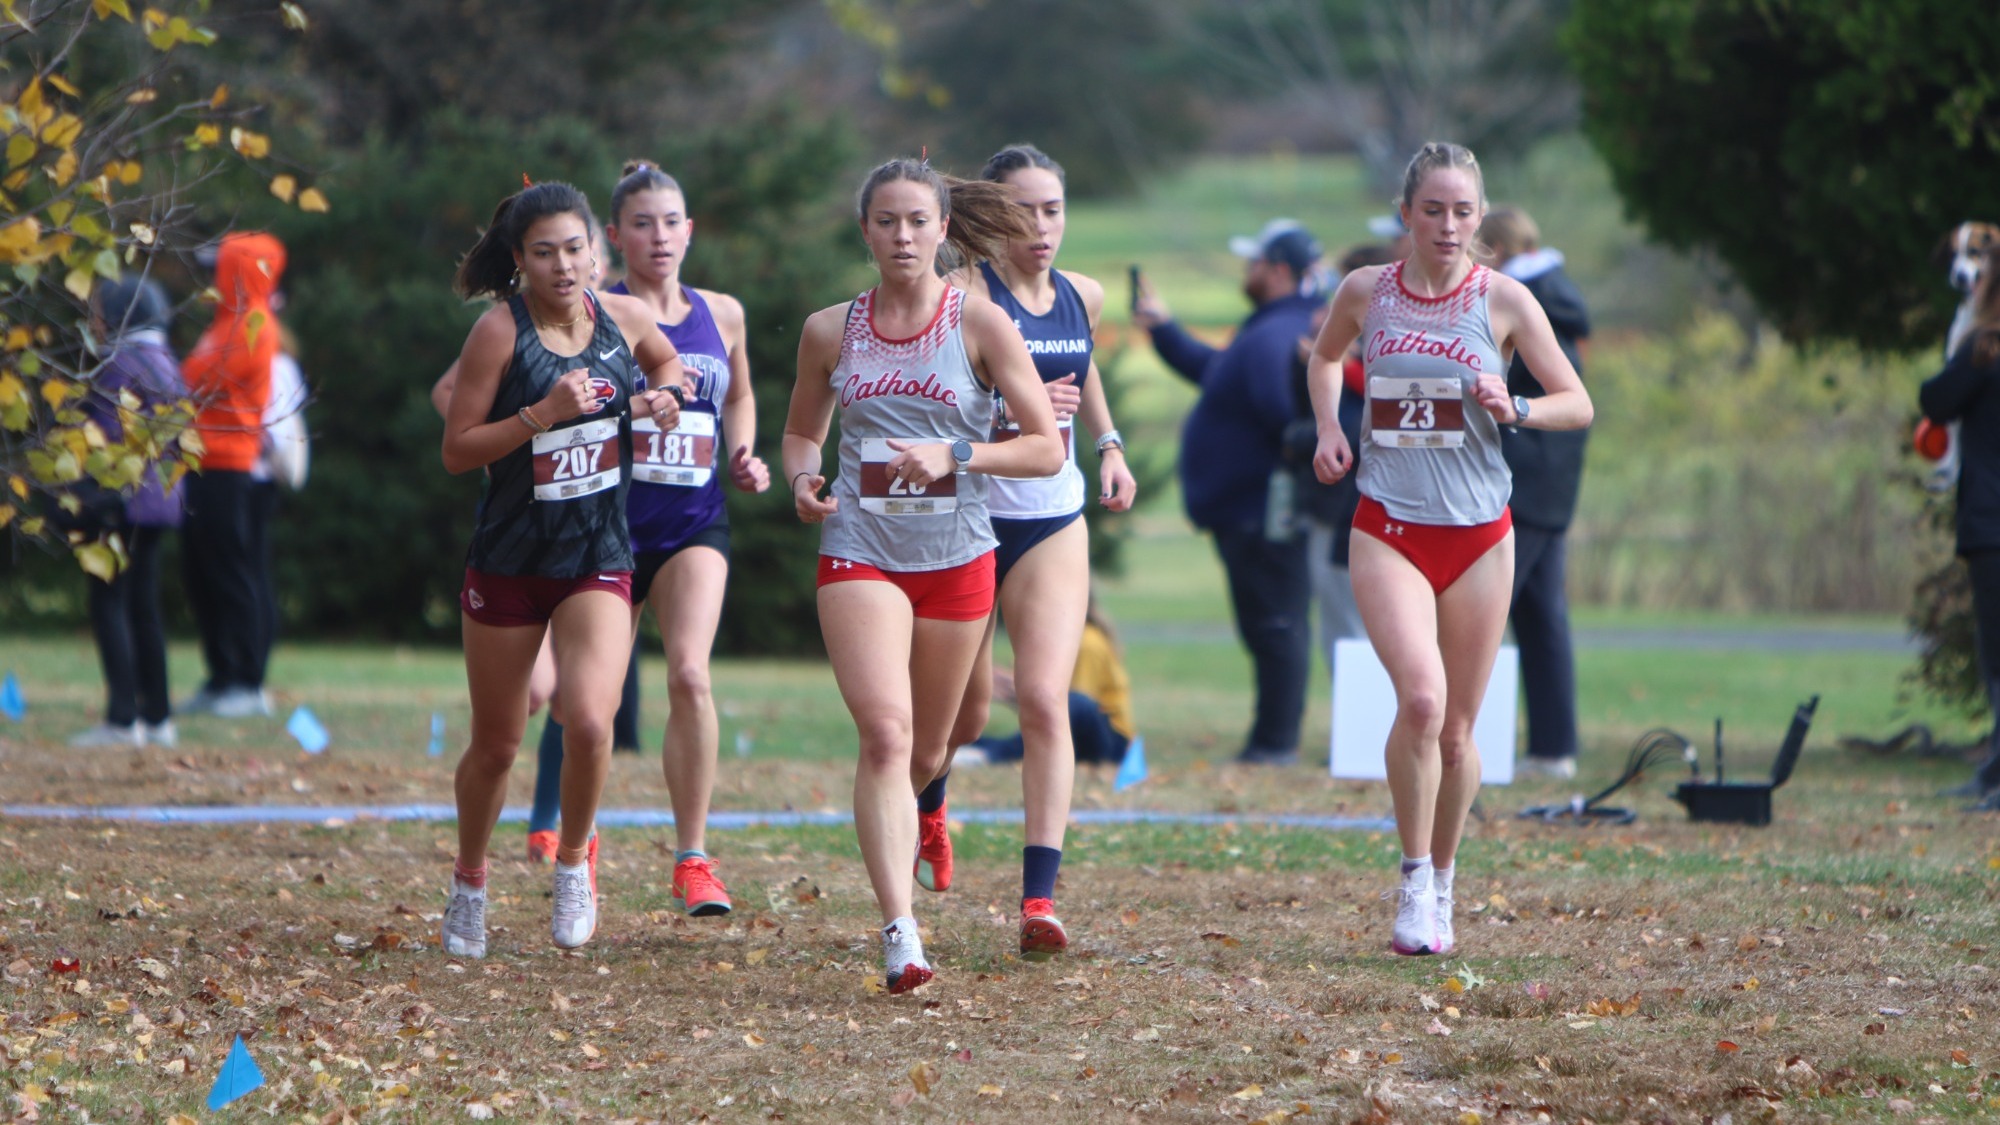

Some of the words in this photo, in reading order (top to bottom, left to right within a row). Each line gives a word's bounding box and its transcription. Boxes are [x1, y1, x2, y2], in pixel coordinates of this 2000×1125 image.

[1025, 339, 1087, 354] ORAVIAN
[1367, 329, 1482, 372] Catholic
[840, 368, 958, 408] Catholic
[1398, 399, 1436, 429] 23
[551, 442, 604, 481] 207
[646, 433, 696, 466] 181
